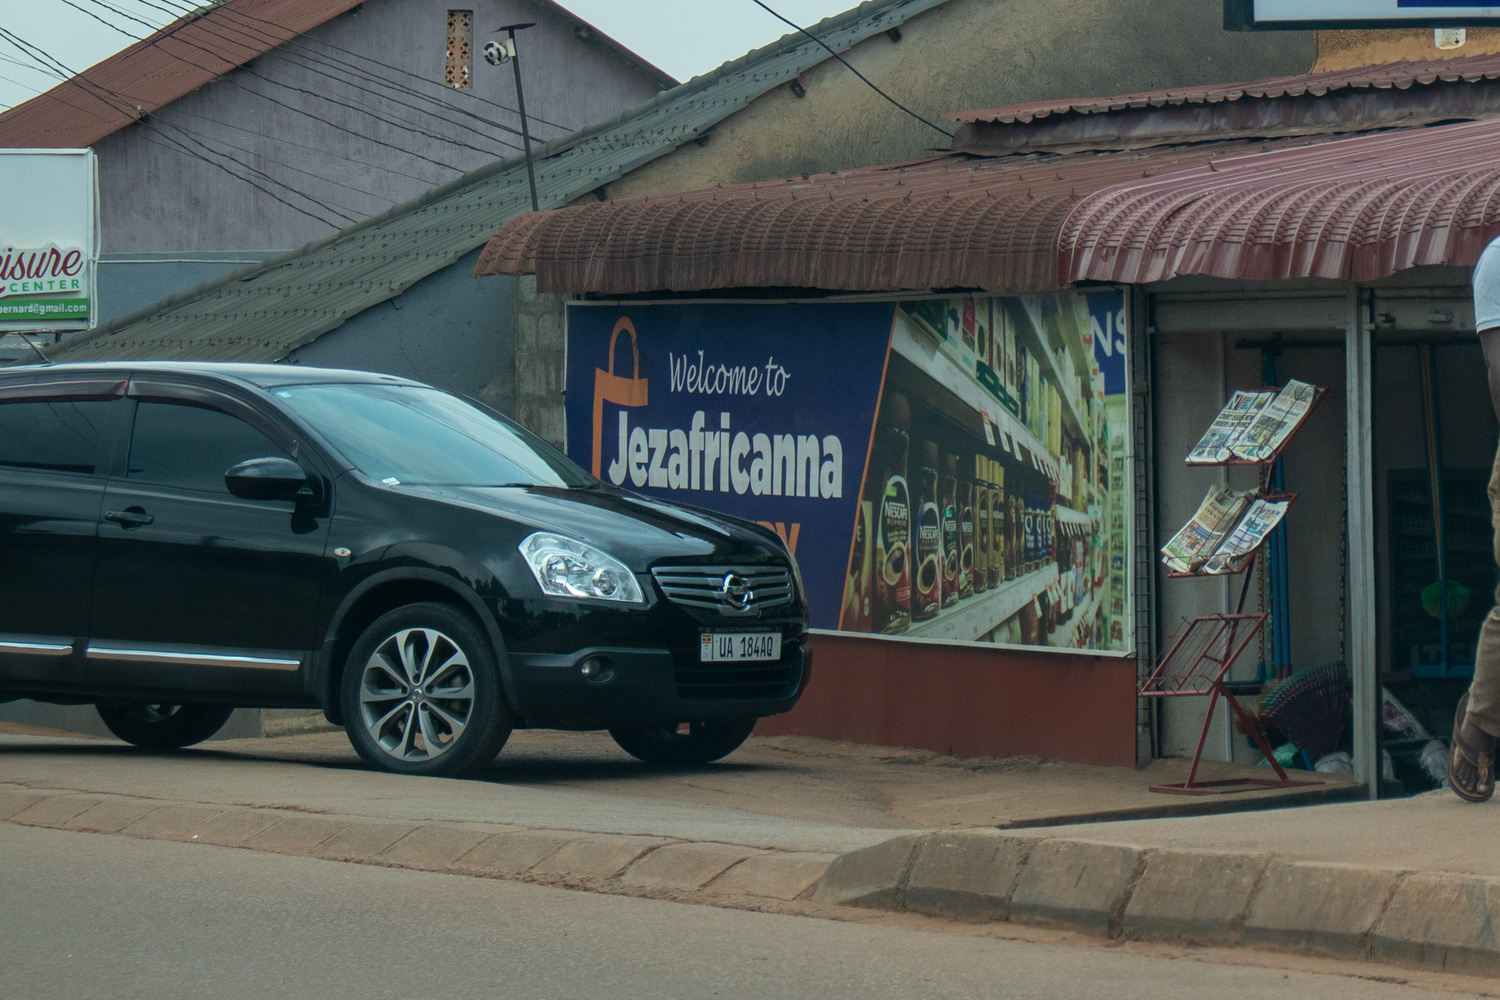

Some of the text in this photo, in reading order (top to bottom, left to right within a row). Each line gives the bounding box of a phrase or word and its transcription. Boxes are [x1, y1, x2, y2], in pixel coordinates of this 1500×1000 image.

[0, 247, 84, 281] isure
[9, 279, 80, 293] CENTER
[669, 350, 791, 397] Welcome to
[608, 410, 843, 500] Jezafricanna
[719, 636, 774, 658] UA 184AQ
